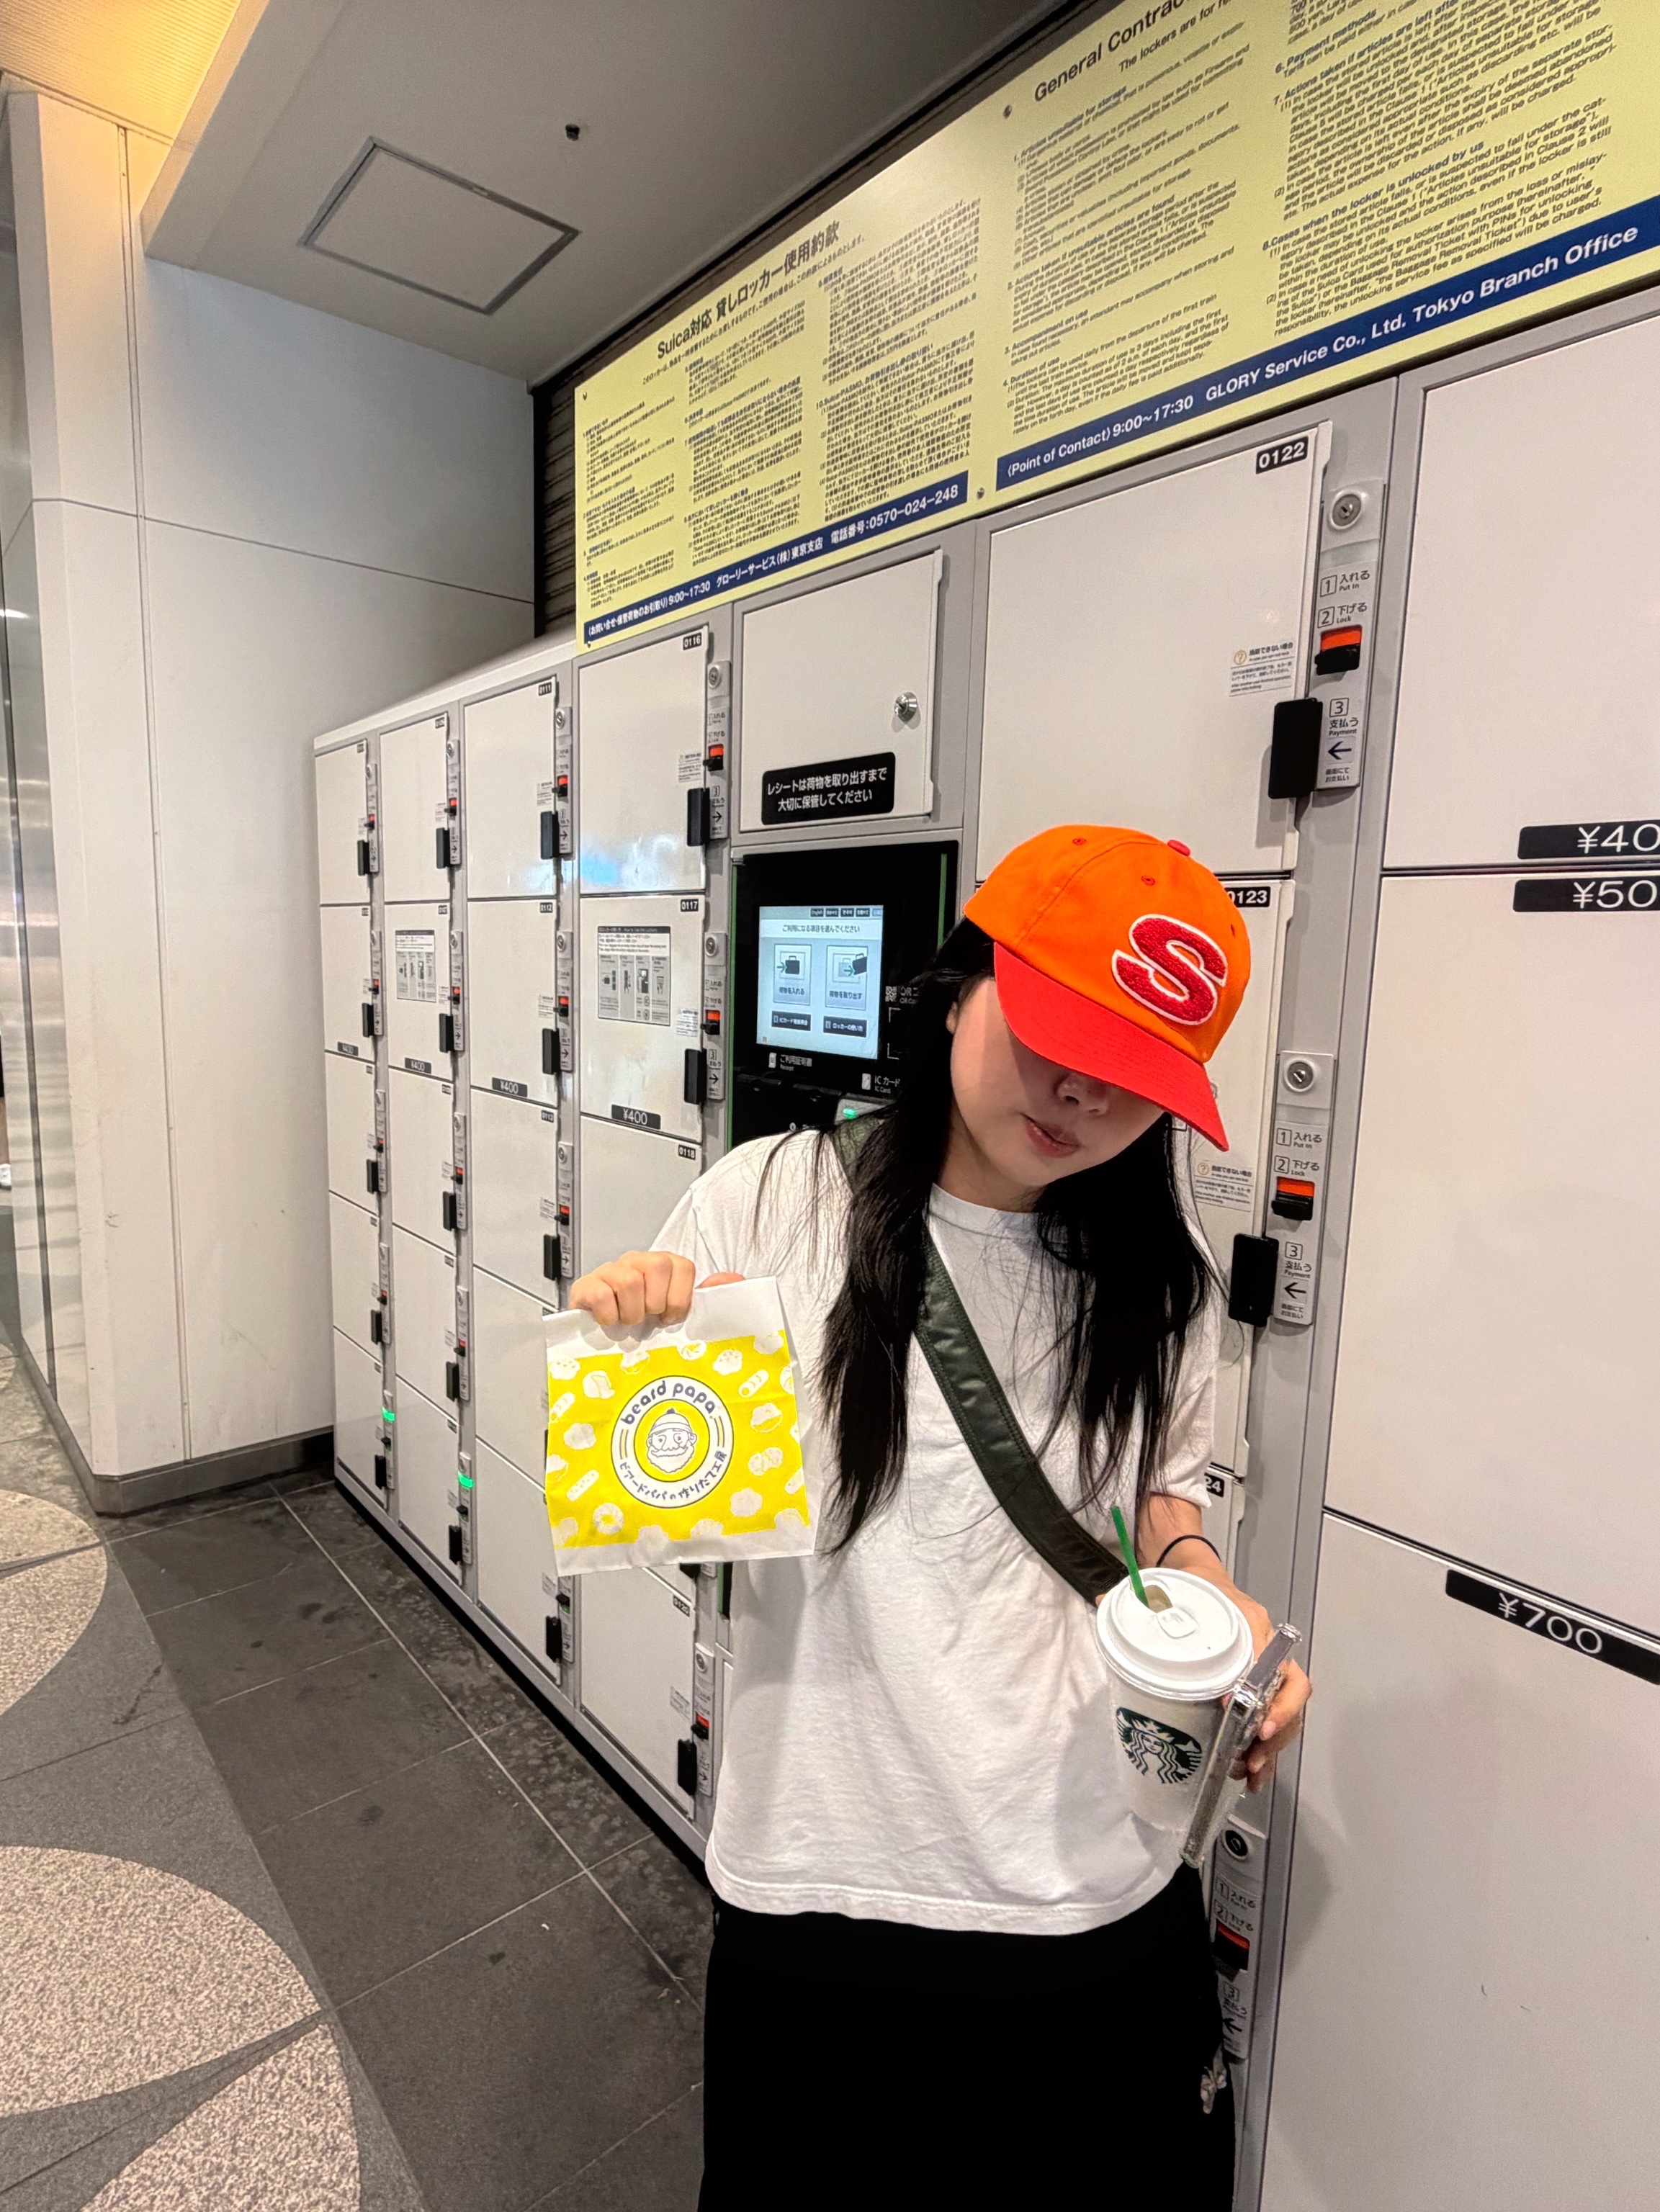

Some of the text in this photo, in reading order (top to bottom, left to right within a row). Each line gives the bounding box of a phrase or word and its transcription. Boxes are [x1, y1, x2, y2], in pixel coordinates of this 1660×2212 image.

[1118, 55, 1136, 72] The
[1140, 29, 1176, 60] lockers
[1180, 16, 1195, 34] are
[1199, 2, 1215, 21] for
[1286, 35, 1329, 67] Payment
[1332, 9, 1376, 41] methods
[1284, 76, 1317, 99] Actions
[1320, 60, 1345, 80] taken
[1357, 32, 1393, 59] articles
[1396, 22, 1412, 37] are
[1415, 9, 1432, 27] left
[1034, 42, 1101, 101] General
[1303, 214, 1328, 231] when
[1332, 205, 1347, 218] the
[1350, 187, 1383, 210] locker
[1386, 182, 1395, 193] is
[1398, 155, 1449, 186] unlocked
[1452, 148, 1467, 162] by
[1470, 141, 1484, 153] us
[1276, 307, 1289, 318] the
[1334, 282, 1347, 293] the
[1350, 265, 1388, 287] Baggage
[1391, 246, 1431, 269] Removal
[1435, 232, 1466, 251] Ticket
[1468, 222, 1489, 237] with
[1491, 212, 1517, 228] PINs
[1520, 203, 1535, 216] for
[1538, 179, 1592, 208] unlocking
[1277, 297, 1288, 308] ing
[1302, 287, 1314, 297] the
[1316, 276, 1340, 291] Suica
[1342, 264, 1363, 280] Card
[1366, 254, 1387, 271] used
[1390, 248, 1402, 260] for
[1405, 221, 1469, 254] authorization
[1471, 202, 1514, 227] purpose
[1274, 309, 1332, 336] responsibility,
[1334, 301, 1347, 312] the
[1350, 282, 1392, 306] unlocking
[1395, 268, 1430, 287] service
[1433, 260, 1448, 272] fee
[1465, 233, 1512, 259] specified
[1515, 224, 1533, 238] will
[1535, 219, 1549, 230] be
[1551, 197, 1601, 224] charged.
[1275, 317, 1288, 327] the
[1291, 304, 1316, 321] locker
[1395, 255, 1436, 277] Baggage
[1439, 235, 1481, 259] Removal
[1528, 209, 1548, 222] due
[658, 308, 712, 359] Suica対応
[716, 222, 839, 320] 貸しロッカー使用約款
[1043, 447, 1054, 465] of
[1206, 368, 1260, 400] GLORY
[1265, 346, 1329, 378] Service
[1332, 335, 1366, 352] Co.,
[1371, 313, 1406, 338] Ltd.
[1412, 290, 1475, 321] Tokyo
[1479, 256, 1558, 297] Branch
[1564, 224, 1638, 266] Office
[1010, 367, 1038, 384] Duration
[1039, 361, 1046, 371] of
[1047, 356, 1059, 367] use
[1258, 441, 1305, 468] 0122
[1339, 583, 1351, 592] Put
[1340, 570, 1370, 584] 入れる
[1336, 615, 1352, 624] Lock
[1337, 602, 1368, 616] 下げる
[683, 636, 701, 647] 0116
[1329, 717, 1359, 729] 支払う
[1329, 728, 1358, 737] Payment
[768, 768, 887, 795] レシートは荷物を取り出すまで
[778, 789, 873, 812] 大切に保管してください
[1577, 824, 1660, 853] ¥40
[681, 901, 699, 911] 0117
[1573, 880, 1657, 909] ¥50
[1111, 914, 1228, 1026] S
[623, 1107, 647, 1125] ¥400
[1294, 1132, 1322, 1143] 入れる
[1293, 1159, 1320, 1172] 下げる
[1285, 1261, 1312, 1273] 支払う
[621, 1380, 716, 1425] beard papa
[1205, 1475, 1222, 1493] 24
[1498, 1592, 1602, 1654] ¥700
